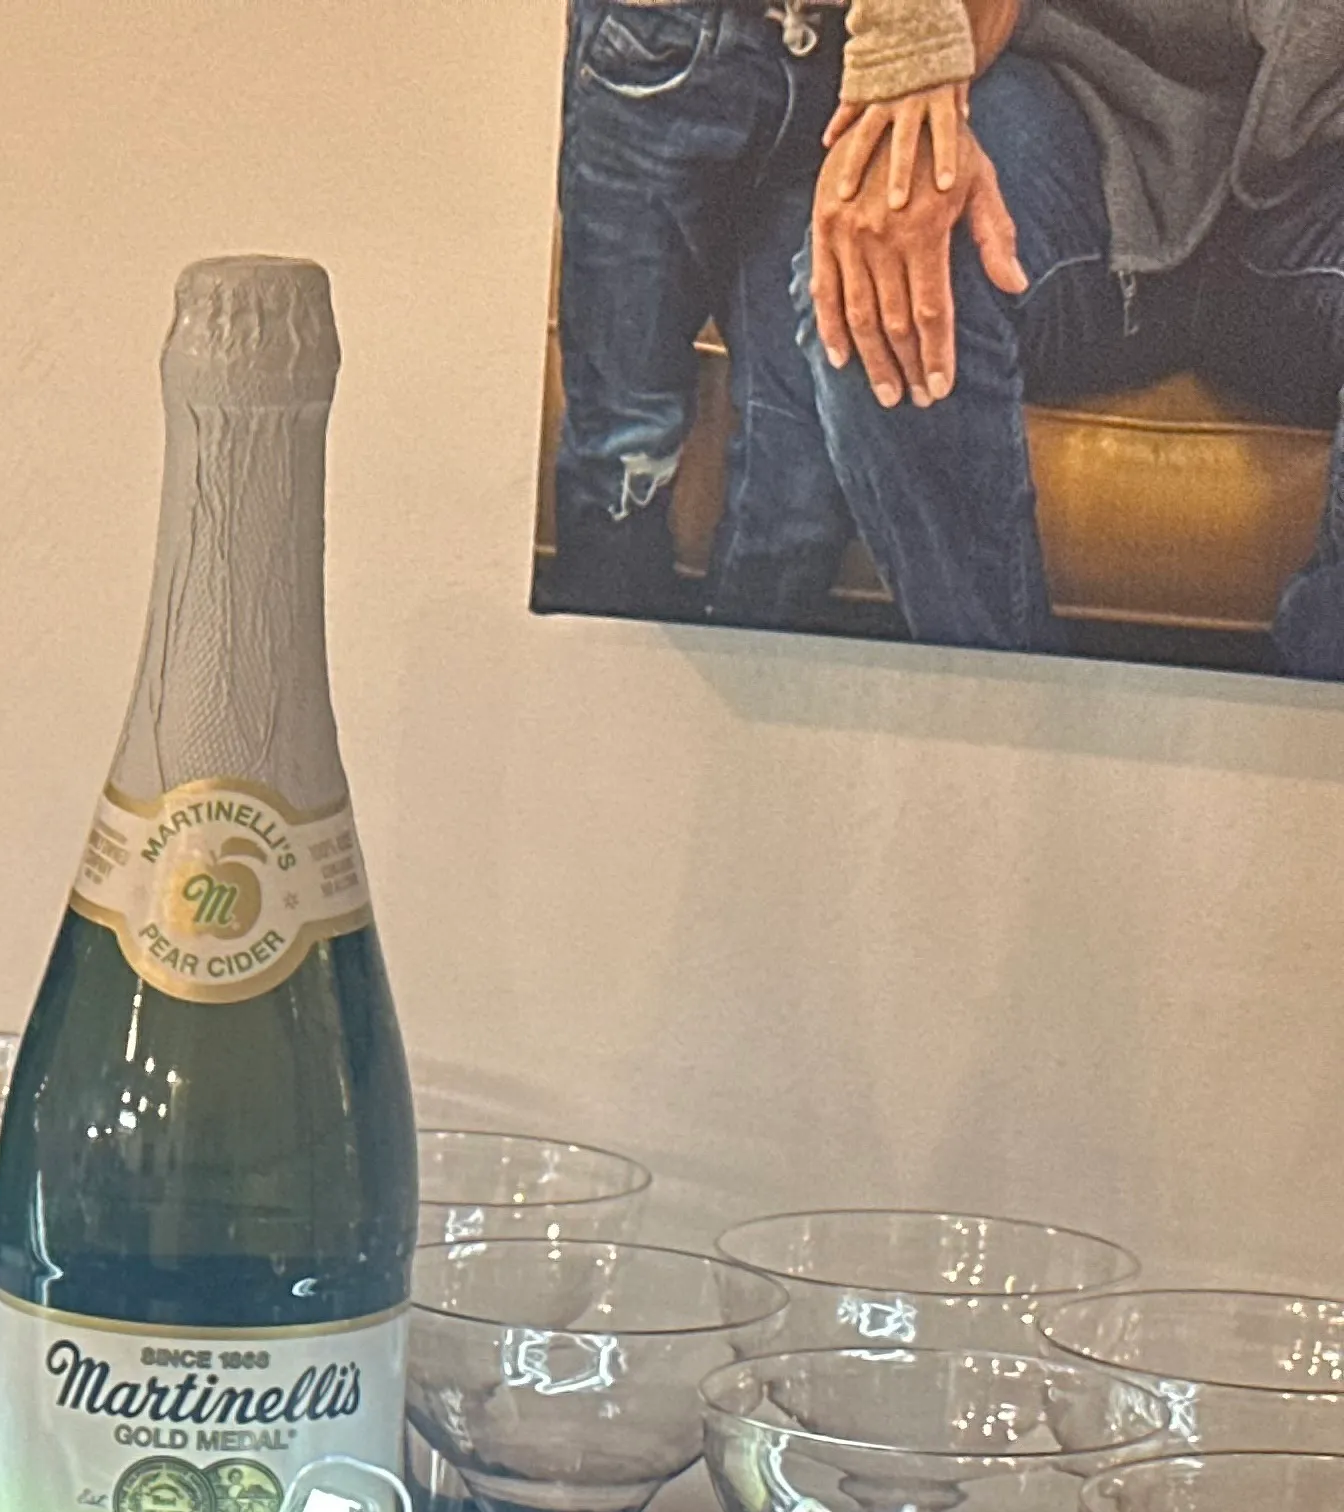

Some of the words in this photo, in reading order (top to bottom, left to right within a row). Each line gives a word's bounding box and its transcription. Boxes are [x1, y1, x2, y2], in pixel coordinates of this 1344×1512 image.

[140, 801, 297, 871] MARTINELLI'S
[138, 922, 199, 975] PEAR
[206, 929, 285, 978] CIDER
[140, 1346, 212, 1367] SINCE
[114, 1423, 188, 1450] GOLD
[196, 1428, 289, 1451] MEDAL
